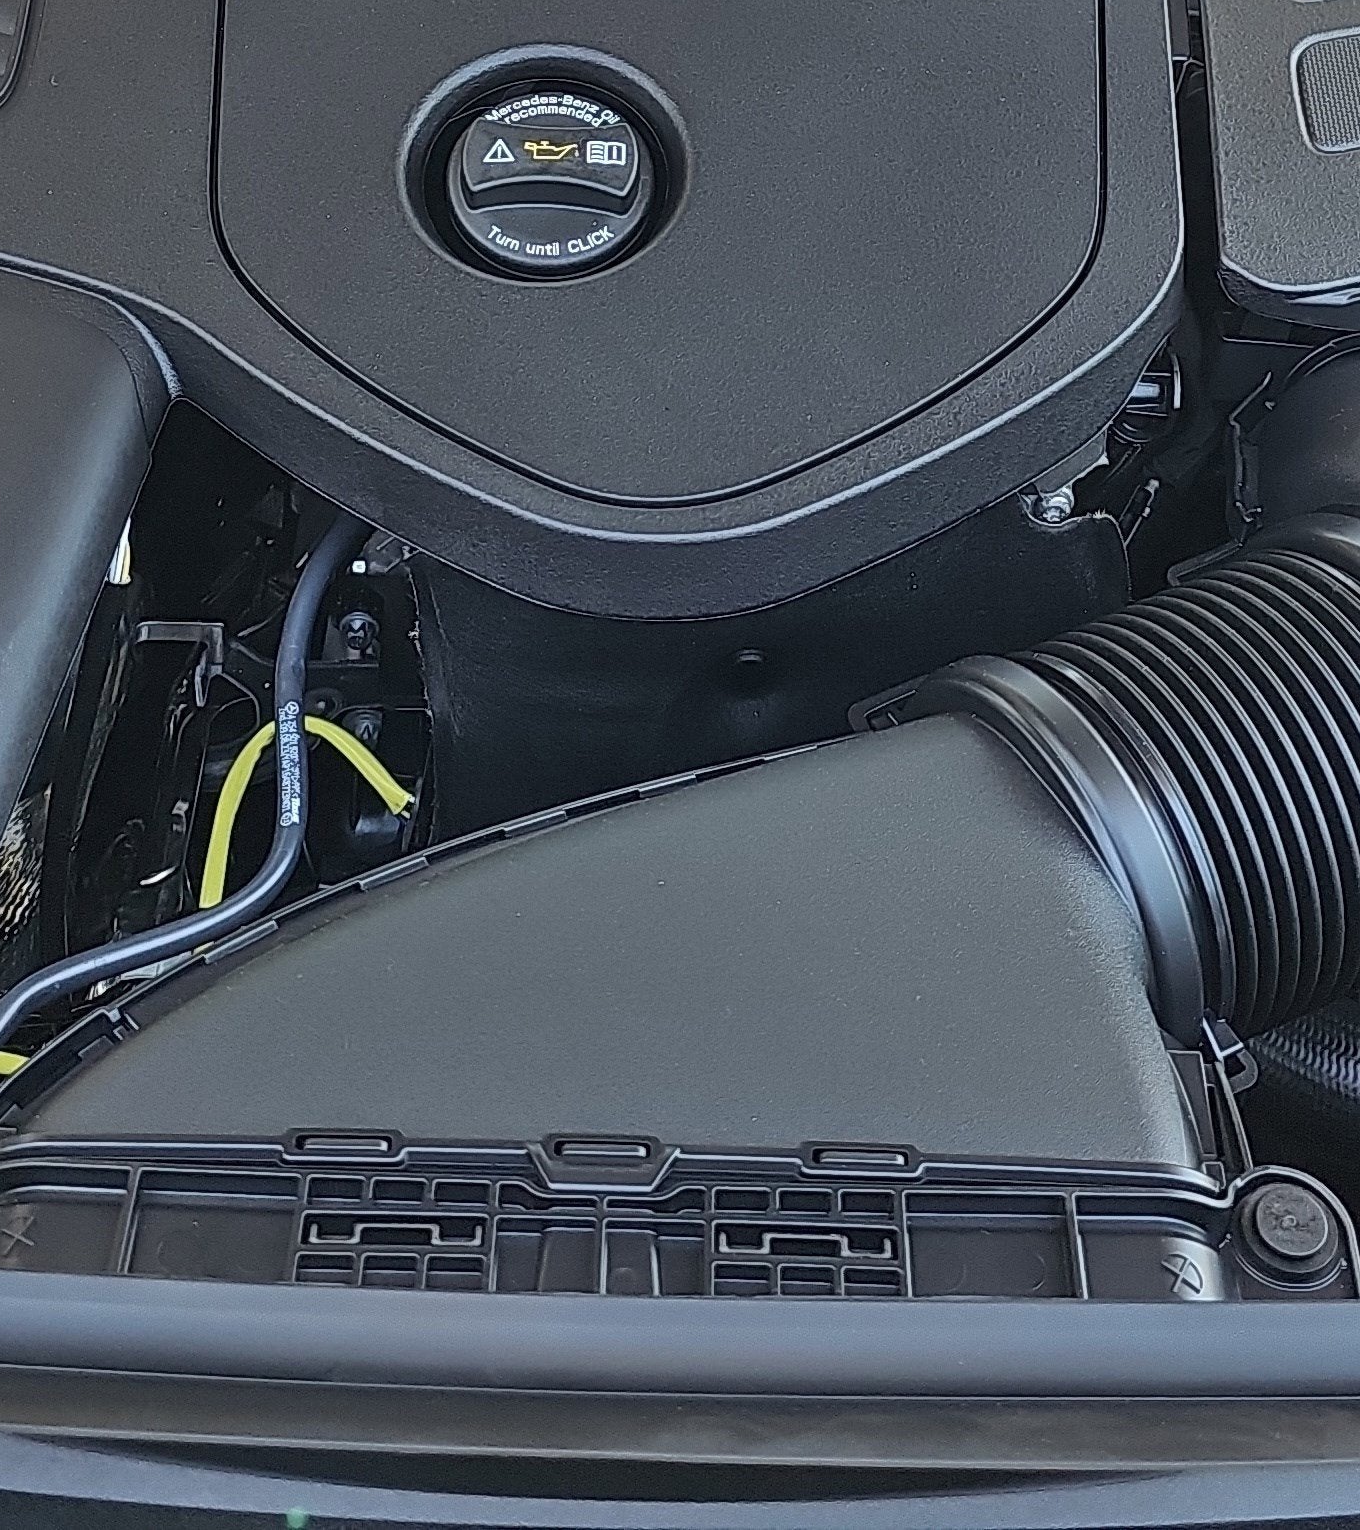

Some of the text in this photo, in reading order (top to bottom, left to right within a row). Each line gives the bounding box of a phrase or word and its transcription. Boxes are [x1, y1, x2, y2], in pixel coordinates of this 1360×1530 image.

[485, 95, 621, 125] Mercedes-Benz Oil
[504, 105, 604, 128] recommended
[487, 225, 615, 256] Turn until CLICK
